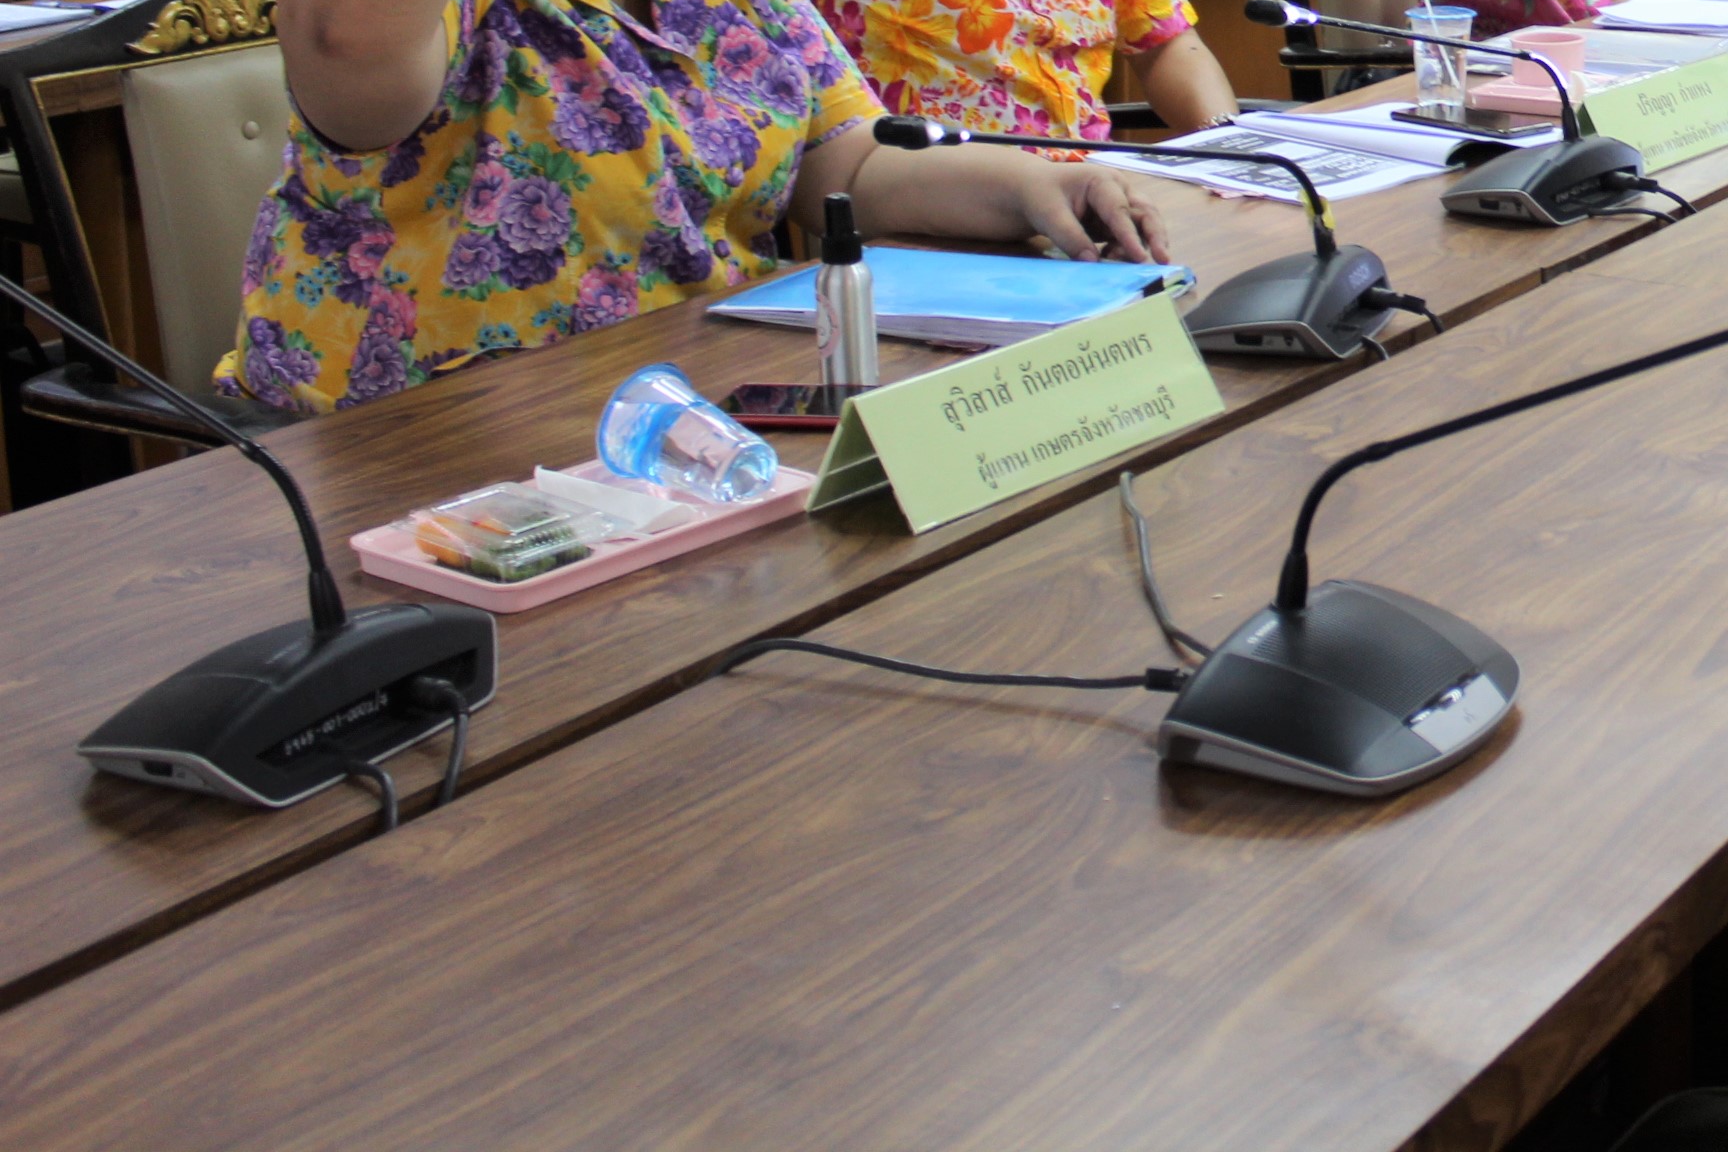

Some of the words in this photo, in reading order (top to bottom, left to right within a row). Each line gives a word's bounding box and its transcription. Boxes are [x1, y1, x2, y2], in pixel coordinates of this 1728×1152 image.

[976, 451, 1031, 490] ผู้แทน
[1031, 384, 1176, 463] เกษตรจังหวัดชลบุรี
